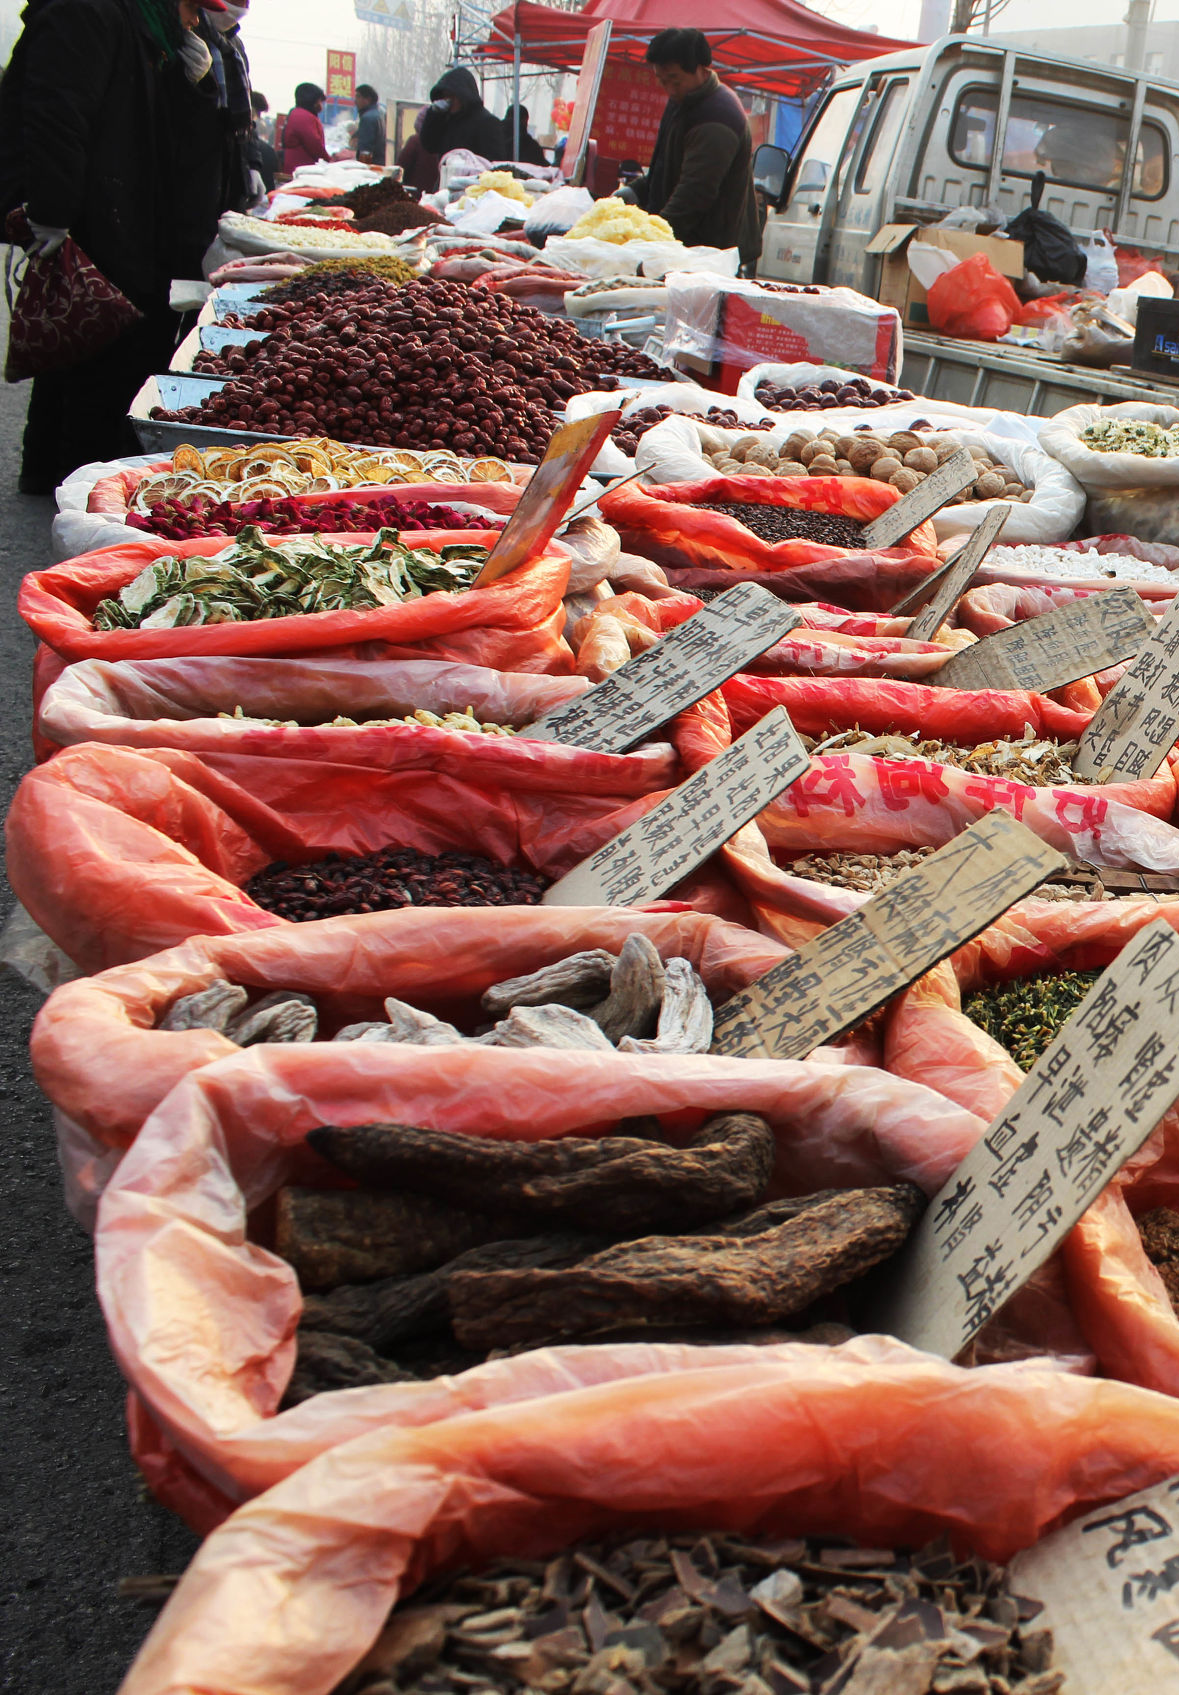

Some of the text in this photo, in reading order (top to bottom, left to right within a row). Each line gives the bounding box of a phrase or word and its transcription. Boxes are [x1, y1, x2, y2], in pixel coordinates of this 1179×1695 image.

[330, 75, 352, 97] 梨
[1083, 717, 1153, 781] 头昏目眩
[1105, 684, 1176, 748] 关节风湿
[716, 742, 761, 822] 补肾壮阳
[641, 802, 691, 888] 尿频尿急
[925, 820, 1048, 910] 天麻
[875, 874, 977, 974] 肢体麻木
[1076, 977, 1179, 1124] 阳痿肾虚
[1027, 1044, 1126, 1205] 早泄遗精
[933, 1175, 1018, 1343] 补肾益精
